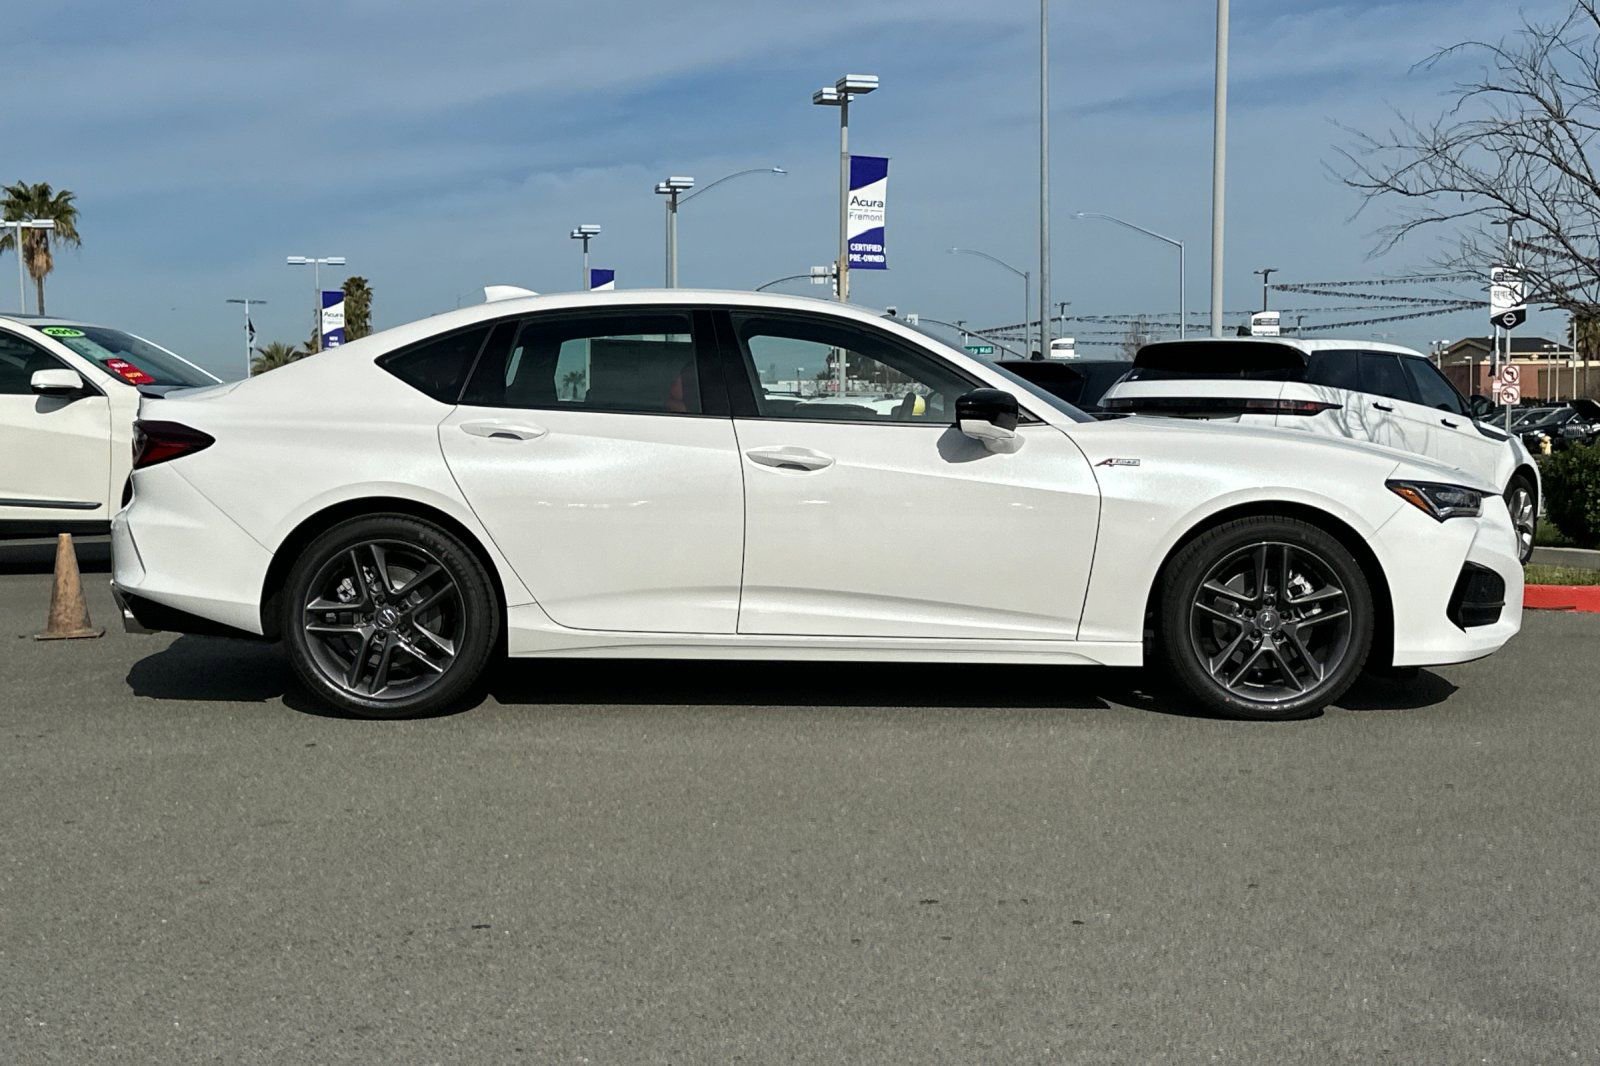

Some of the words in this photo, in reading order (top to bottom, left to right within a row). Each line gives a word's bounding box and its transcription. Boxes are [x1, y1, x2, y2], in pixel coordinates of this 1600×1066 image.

[850, 195, 884, 208] Acura
[849, 212, 883, 222] Fremont
[850, 243, 882, 252] CERTIFIED
[849, 253, 885, 263] PRE-OWNED
